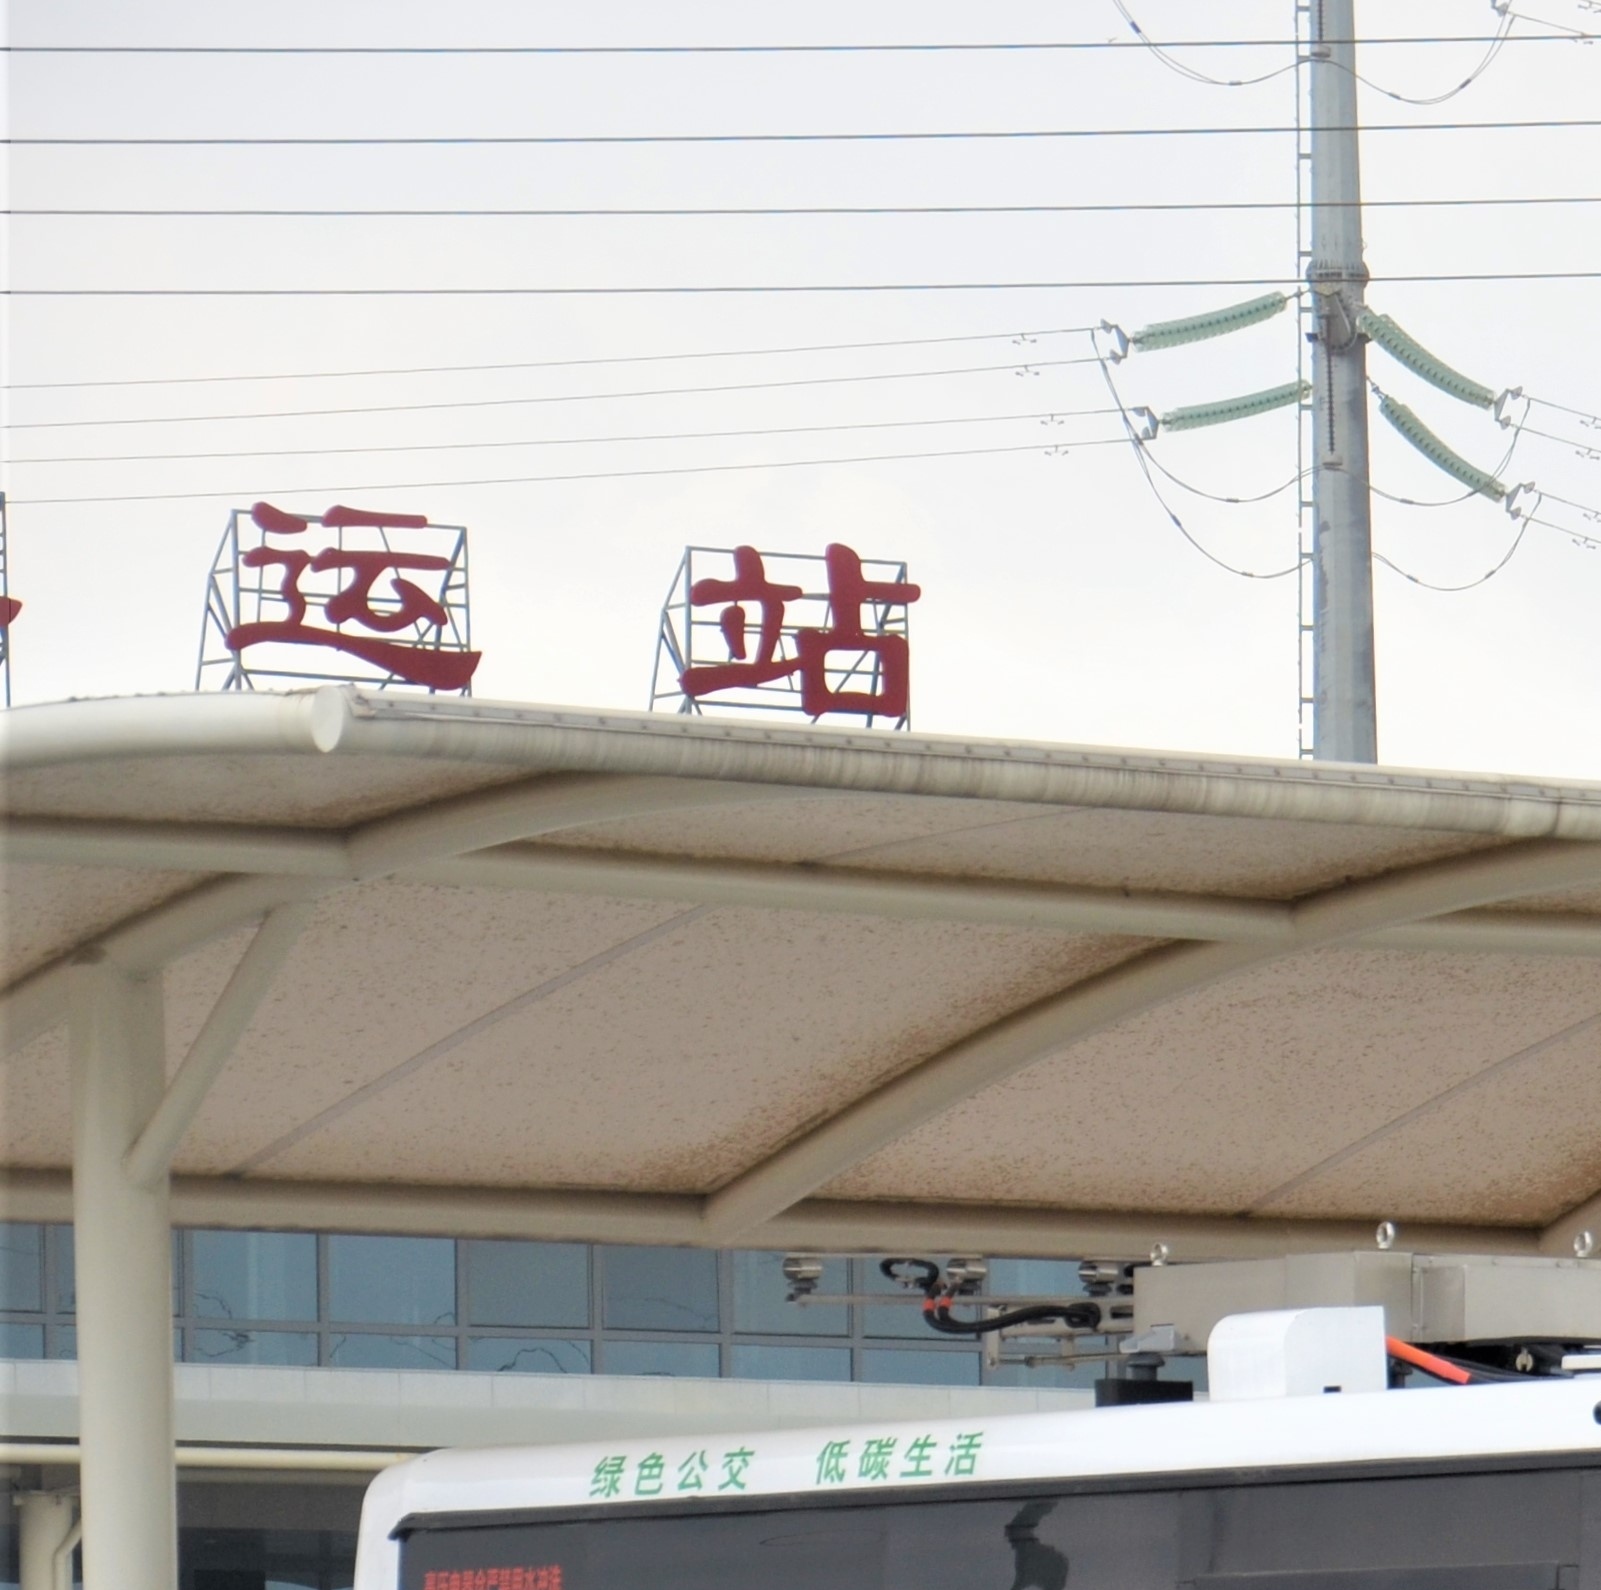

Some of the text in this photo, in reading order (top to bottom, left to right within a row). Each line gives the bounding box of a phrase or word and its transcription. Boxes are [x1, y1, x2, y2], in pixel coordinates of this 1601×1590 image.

[0, 502, 921, 718] 运站
[589, 1432, 984, 1498] 绿色公交 低碳生活
